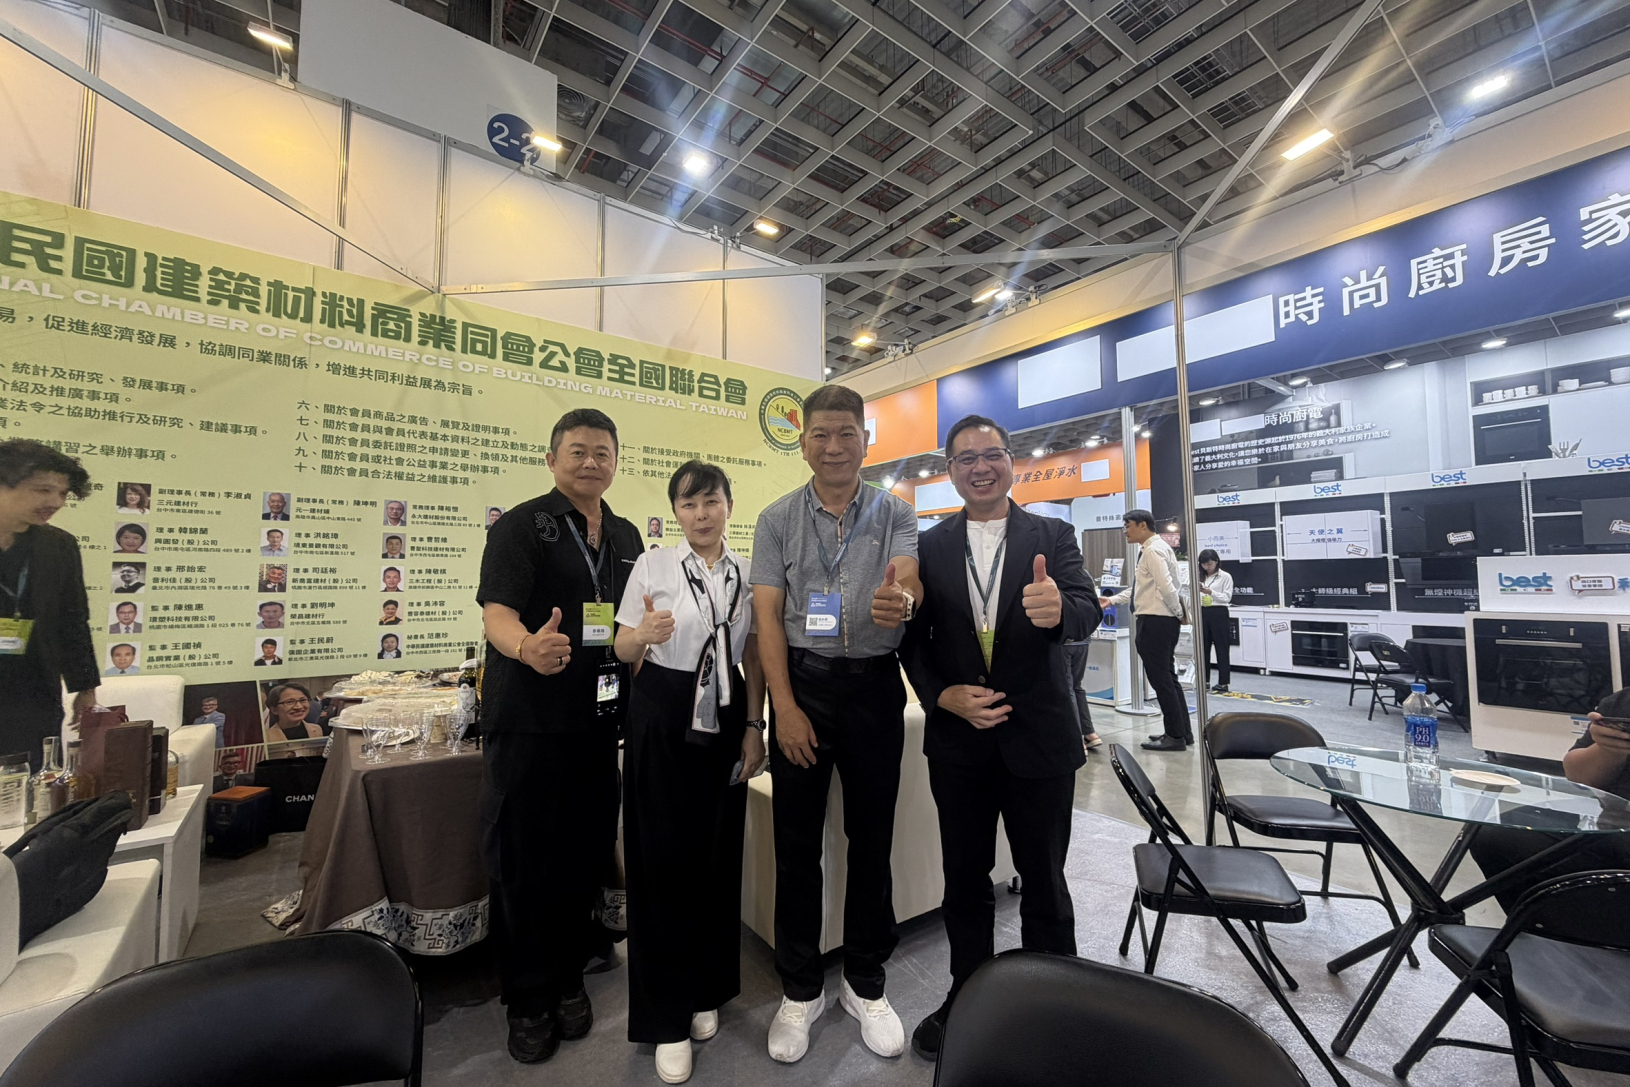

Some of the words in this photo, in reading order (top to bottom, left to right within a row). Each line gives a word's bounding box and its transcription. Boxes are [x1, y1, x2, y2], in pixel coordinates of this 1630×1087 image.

[1278, 193, 1630, 328] 時尚廚房家
[0, 219, 747, 406] 民國建築材料商業同會公會全國聯合會
[74, 289, 248, 333] CHAMBER
[255, 323, 298, 341] OF
[303, 331, 453, 369] COMMERCE
[457, 361, 488, 374] OF
[492, 366, 592, 394] BUILDING
[597, 386, 686, 410] MATERIAL
[689, 401, 747, 420] TAIWAN
[1264, 407, 1324, 426] 時尚廚電
[1587, 454, 1630, 470] best
[1431, 470, 1467, 484] best
[1314, 483, 1342, 495] best
[1217, 493, 1240, 503] best
[1498, 572, 1553, 588] best
[1416, 726, 1429, 735] PH
[285, 794, 315, 803] CHAN
